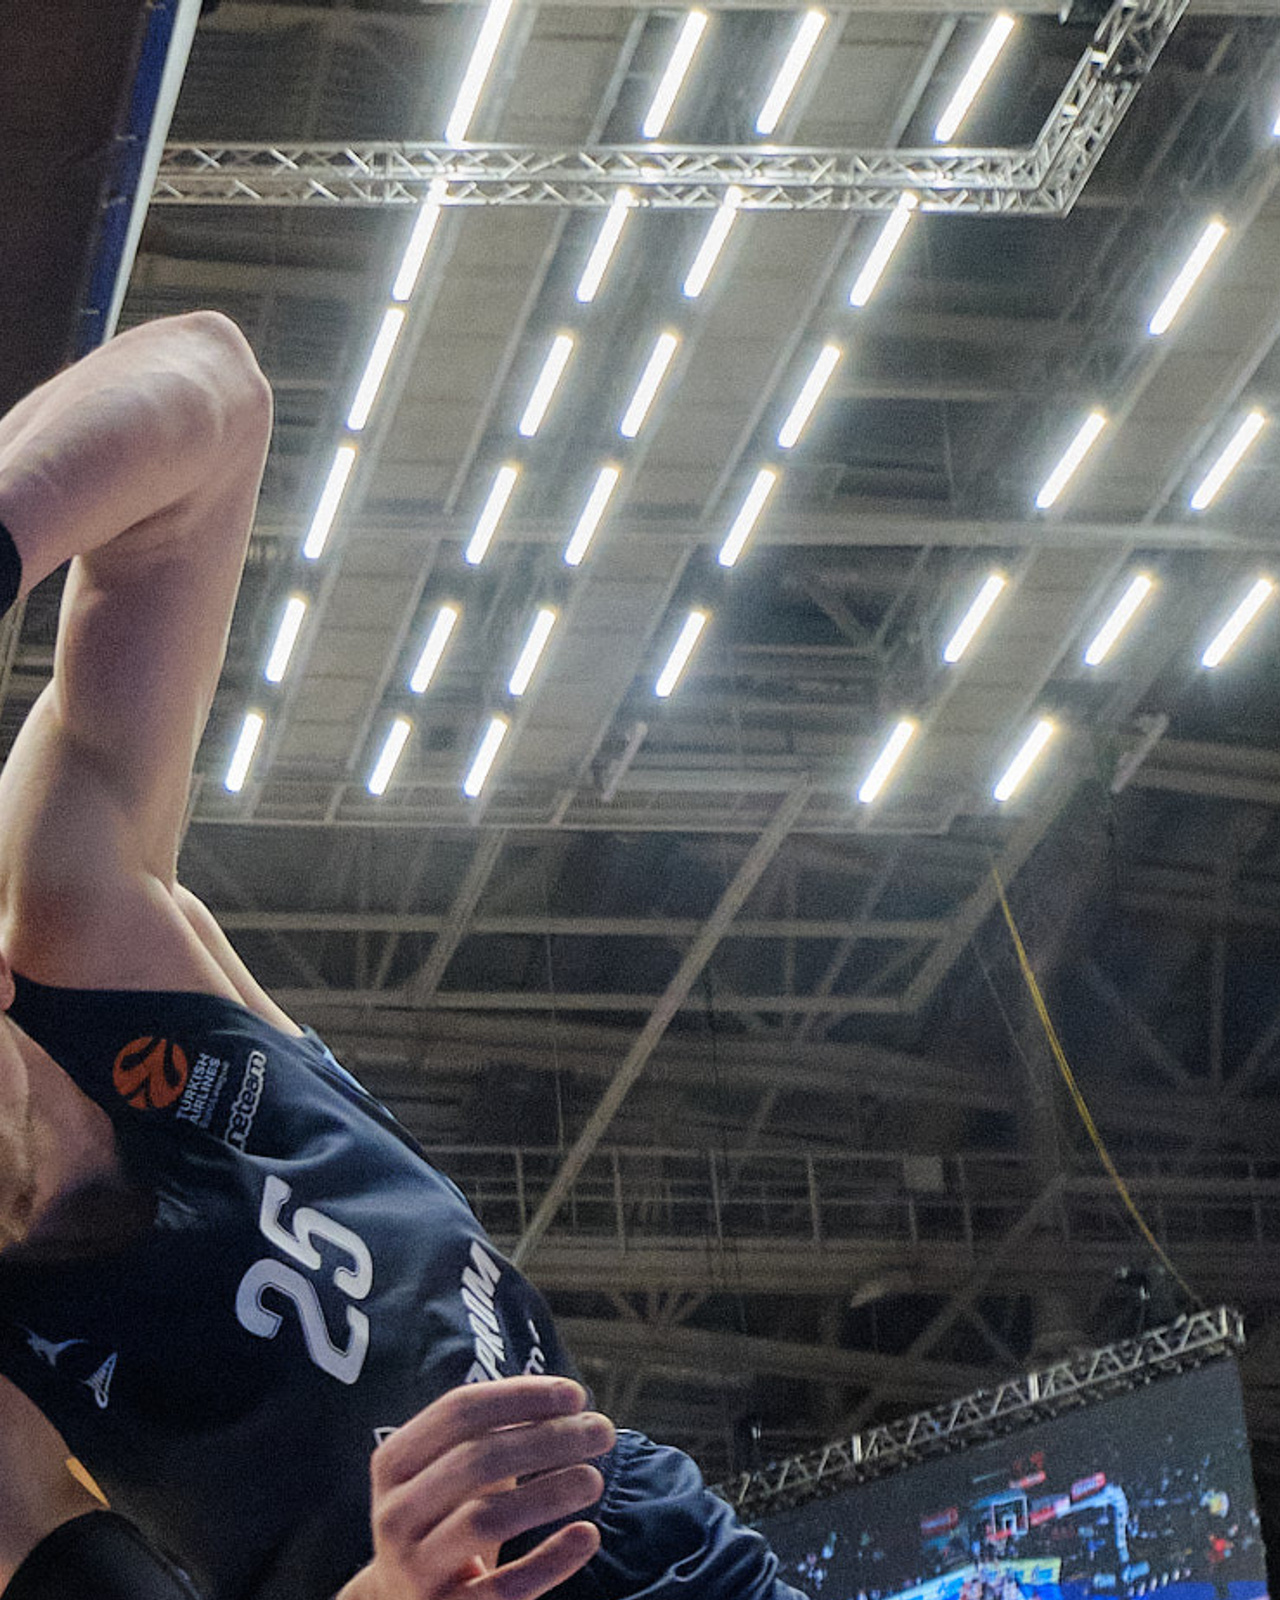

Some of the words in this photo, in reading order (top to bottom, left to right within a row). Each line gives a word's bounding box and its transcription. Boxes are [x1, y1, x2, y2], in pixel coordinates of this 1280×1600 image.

[176, 1052, 211, 1119] TURKISH
[190, 1057, 220, 1126] AIRLINES
[235, 1175, 373, 1386] 25
